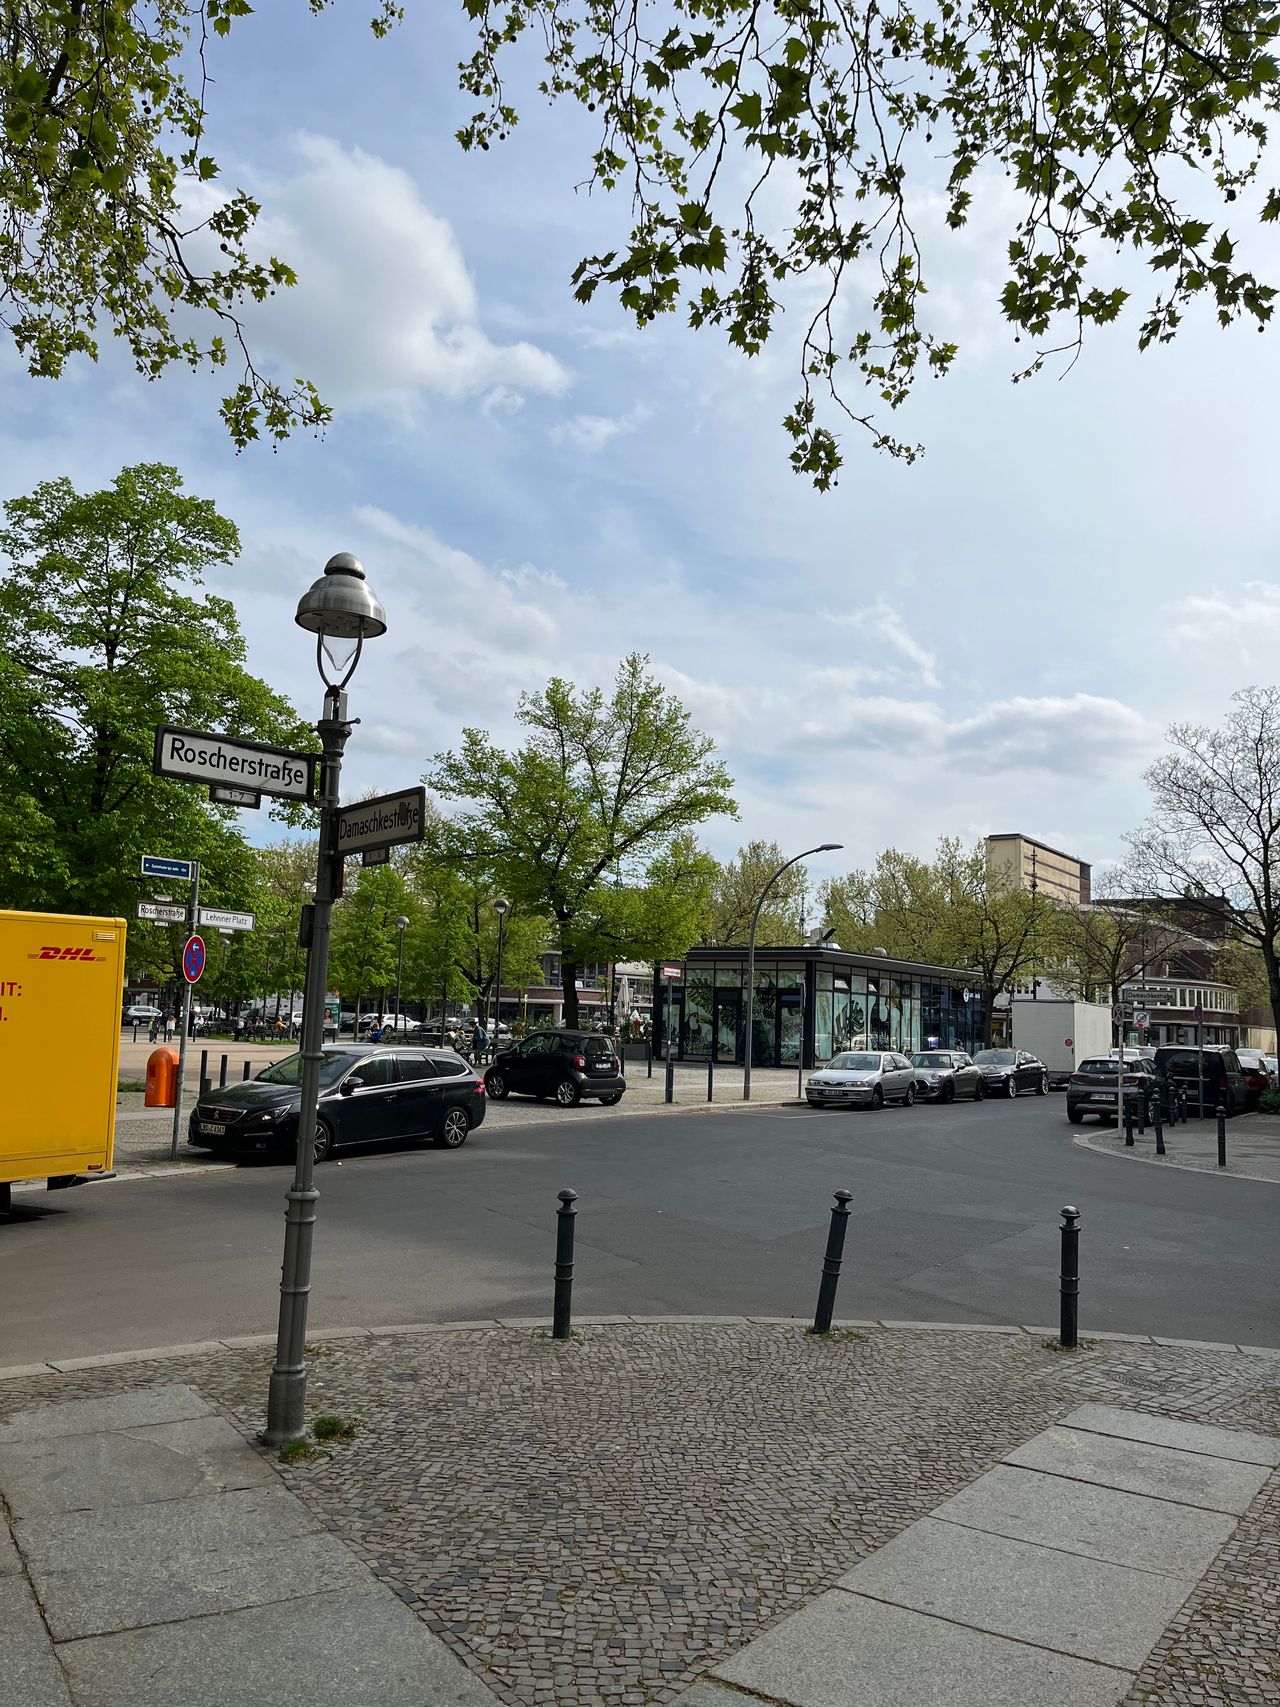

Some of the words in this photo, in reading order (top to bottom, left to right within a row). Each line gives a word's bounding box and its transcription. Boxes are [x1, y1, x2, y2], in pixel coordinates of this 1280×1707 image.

[170, 737, 304, 787] Roscherstraße
[140, 904, 184, 919] Roscherstraße
[206, 912, 231, 923] Lehniner
[232, 915, 248, 926] Platz
[38, 946, 97, 961] DHL
